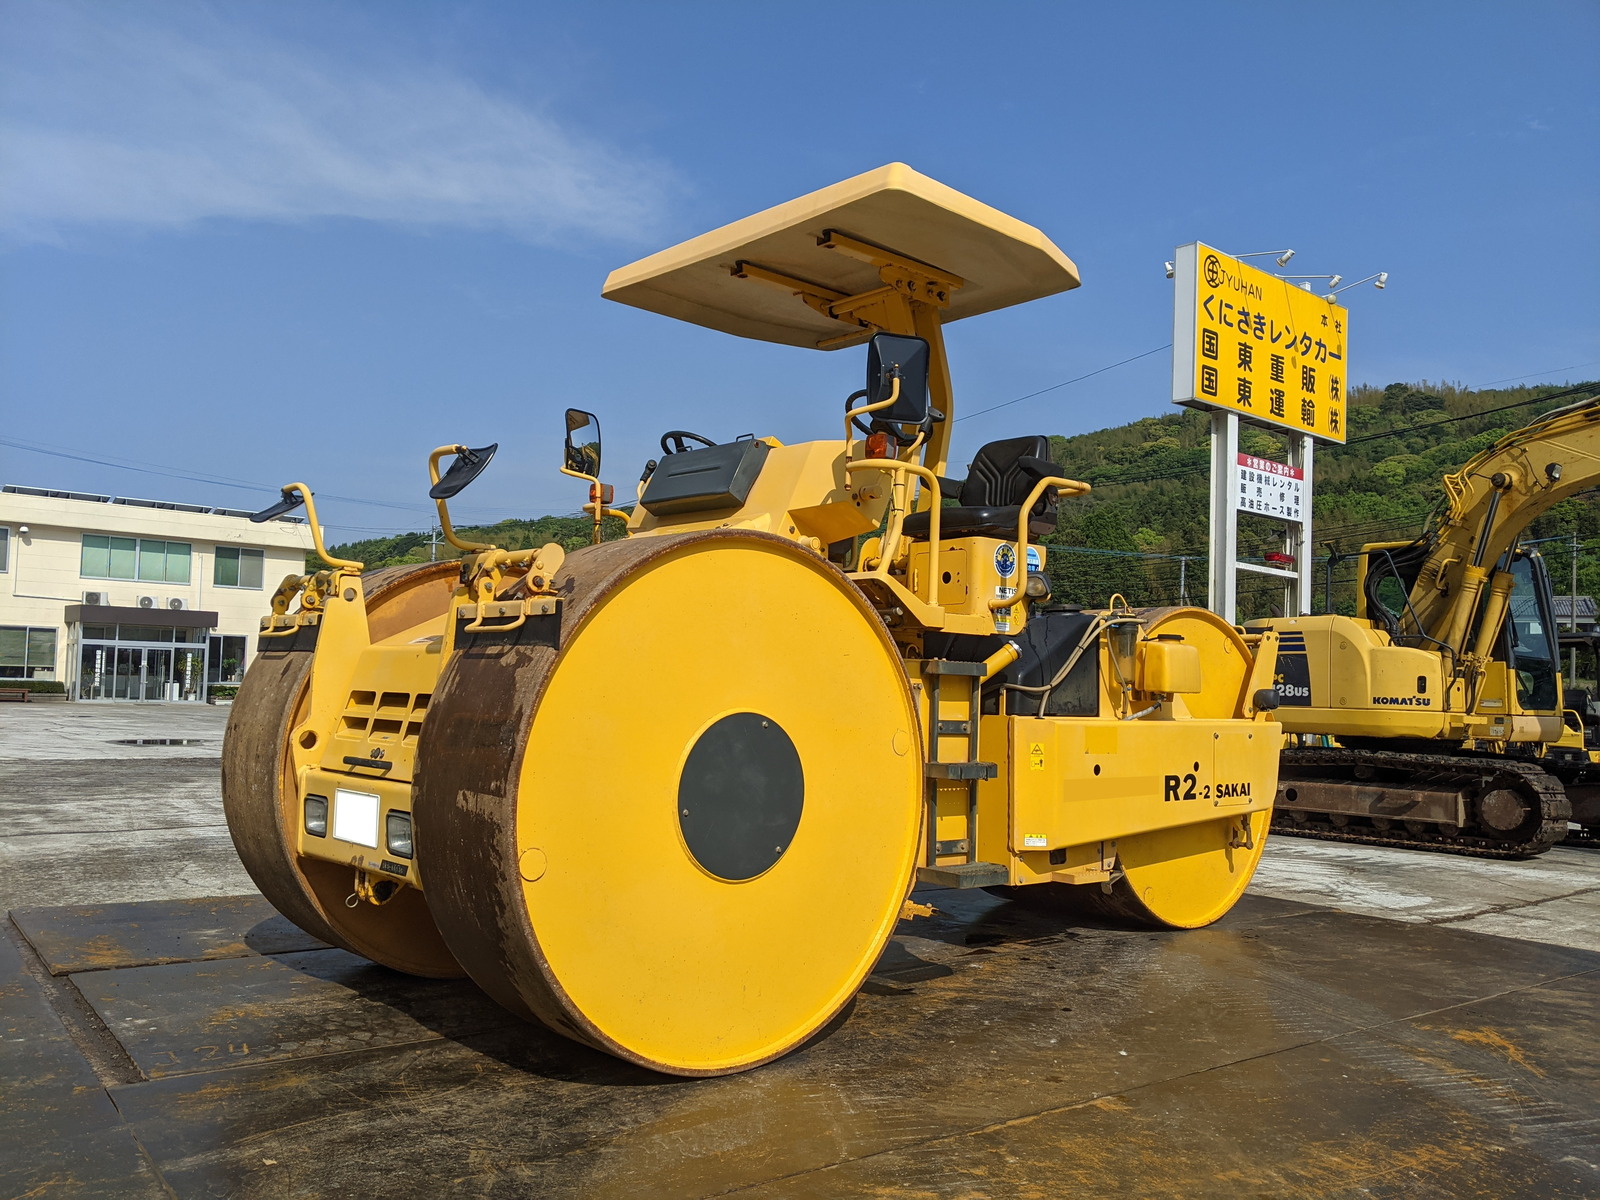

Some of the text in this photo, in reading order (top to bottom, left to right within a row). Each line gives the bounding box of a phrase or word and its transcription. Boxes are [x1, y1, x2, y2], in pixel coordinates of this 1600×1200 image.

[1203, 294, 1342, 364] くにさきレンタカー
[1240, 469, 1300, 493] 建設機械レンタル
[1372, 695, 1431, 706] KOMATSU
[1215, 782, 1251, 799] SAKAI
